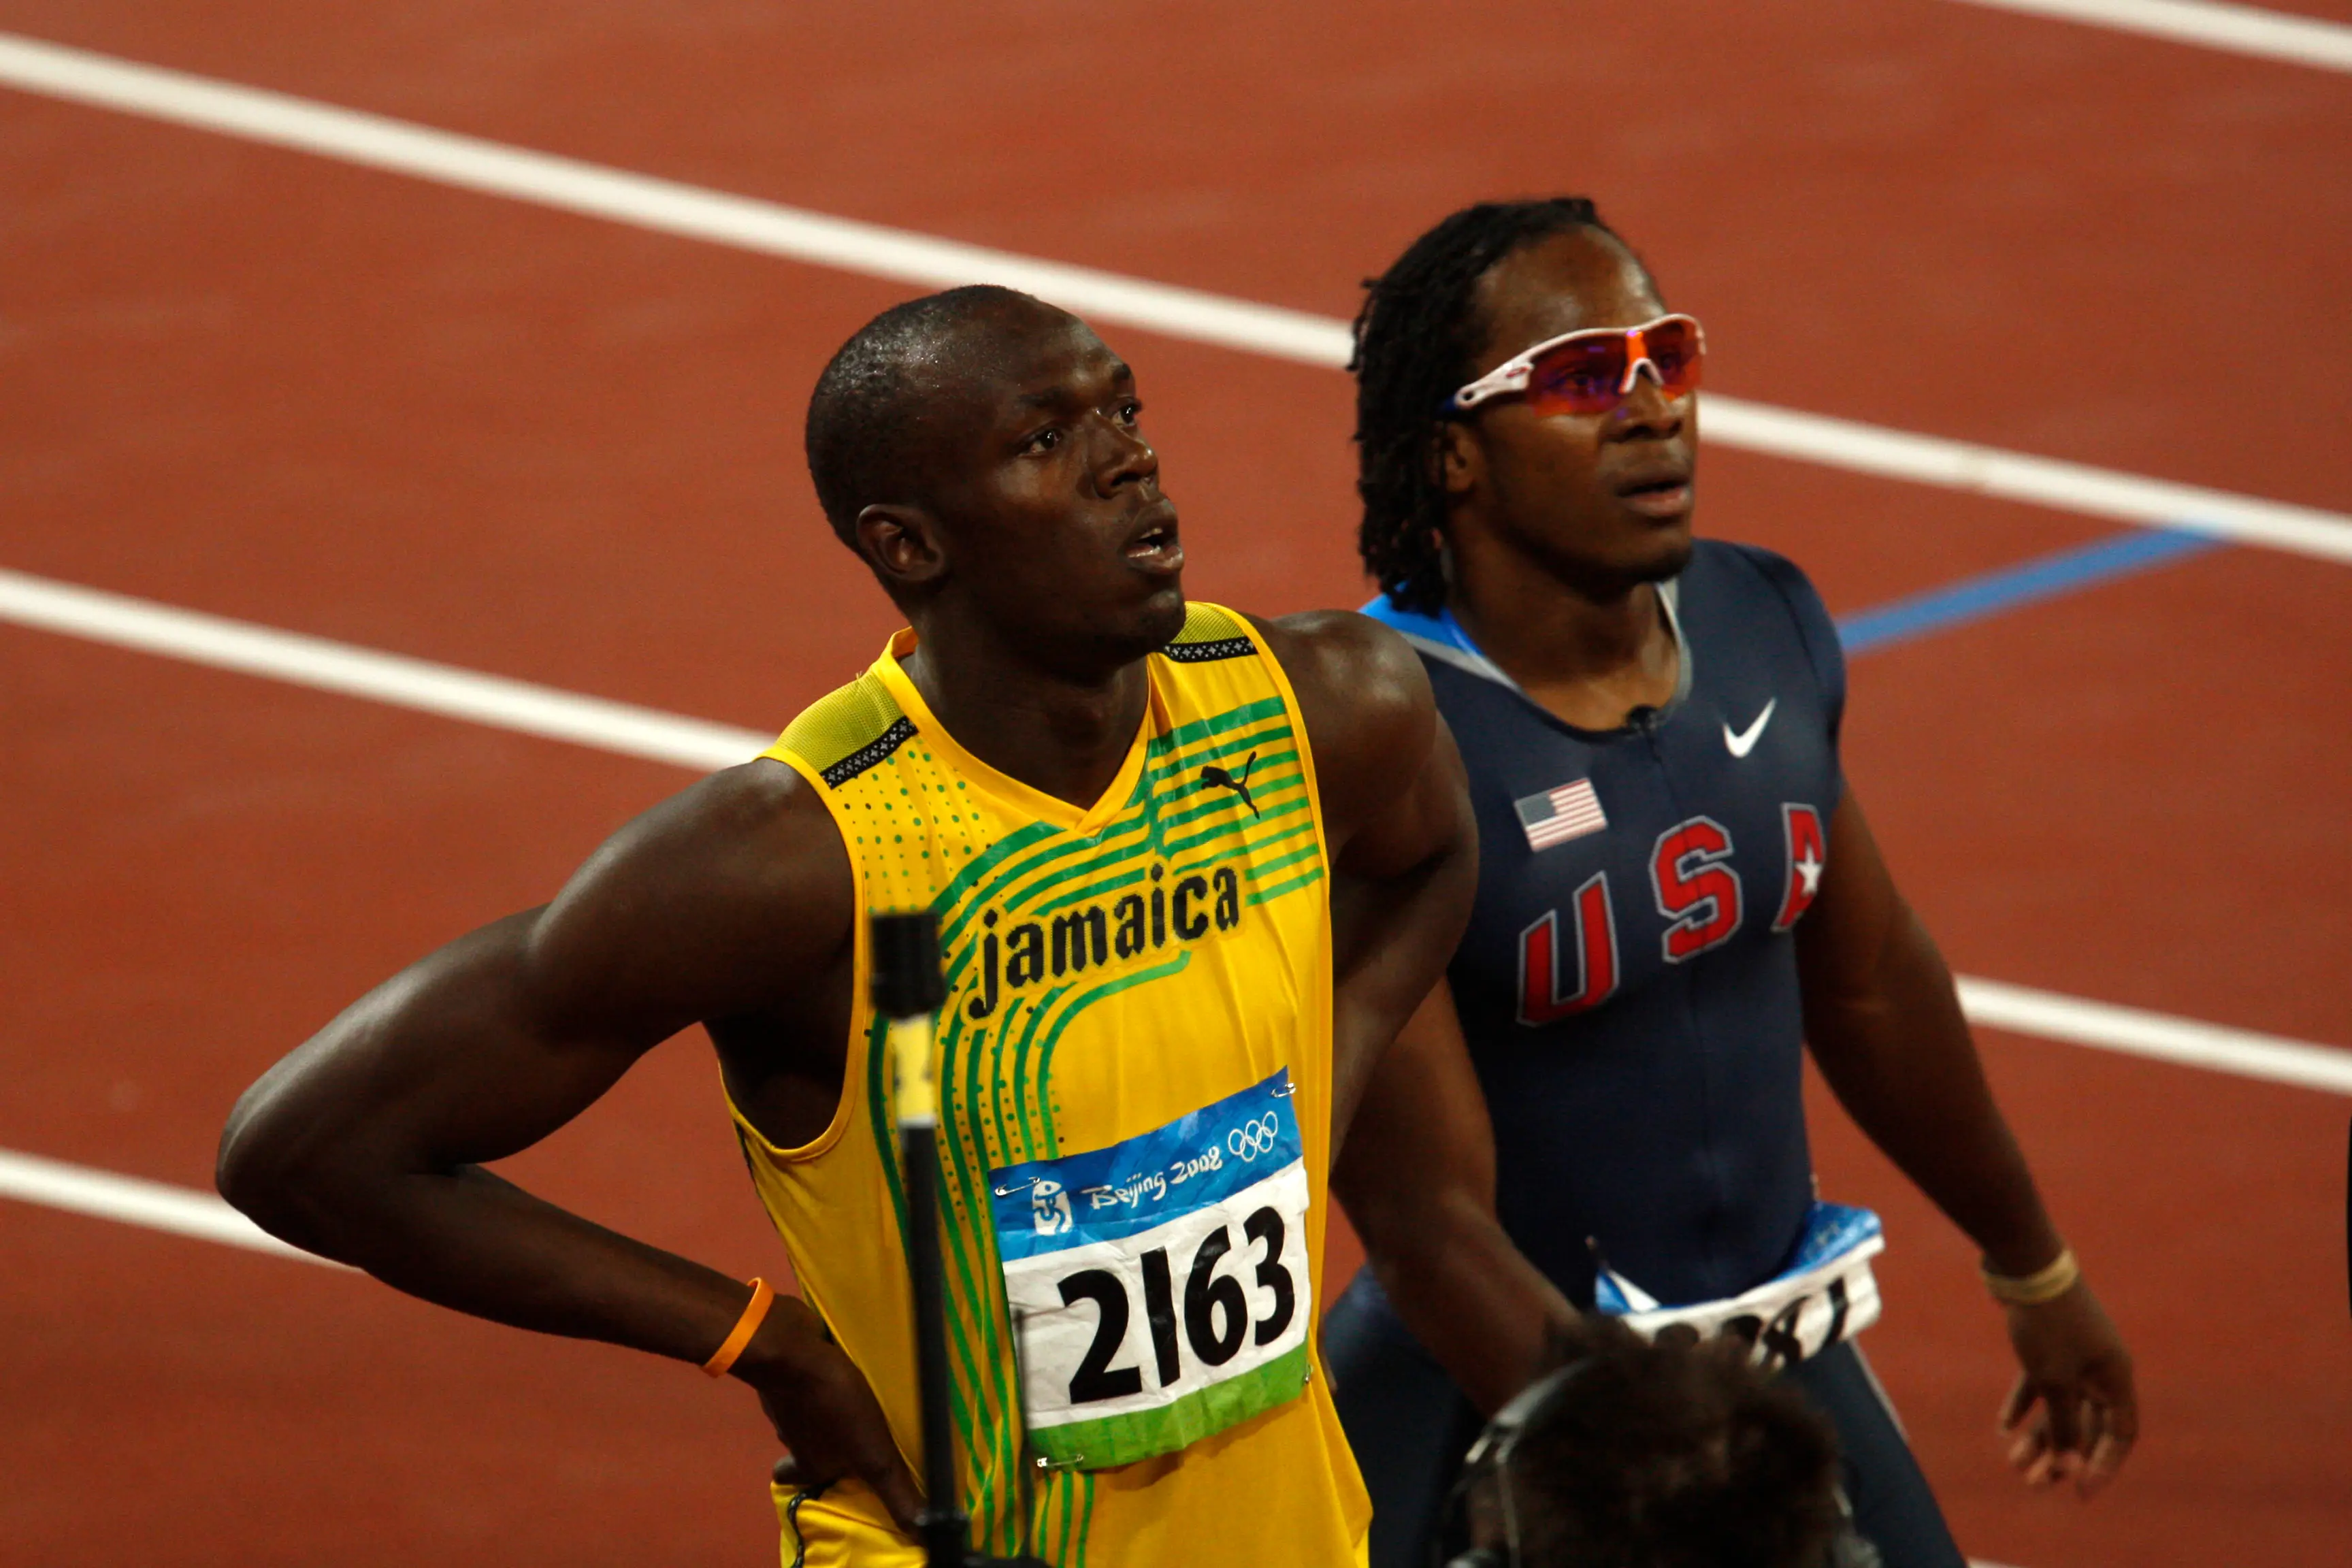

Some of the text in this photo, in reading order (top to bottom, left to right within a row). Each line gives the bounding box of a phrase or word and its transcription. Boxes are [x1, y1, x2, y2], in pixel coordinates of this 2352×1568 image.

[968, 862, 1239, 1019] jamaica
[1516, 802, 1827, 1028] USA
[1081, 1146, 1223, 1210] Beijing 2008
[1057, 1205, 1295, 1405] 2163
